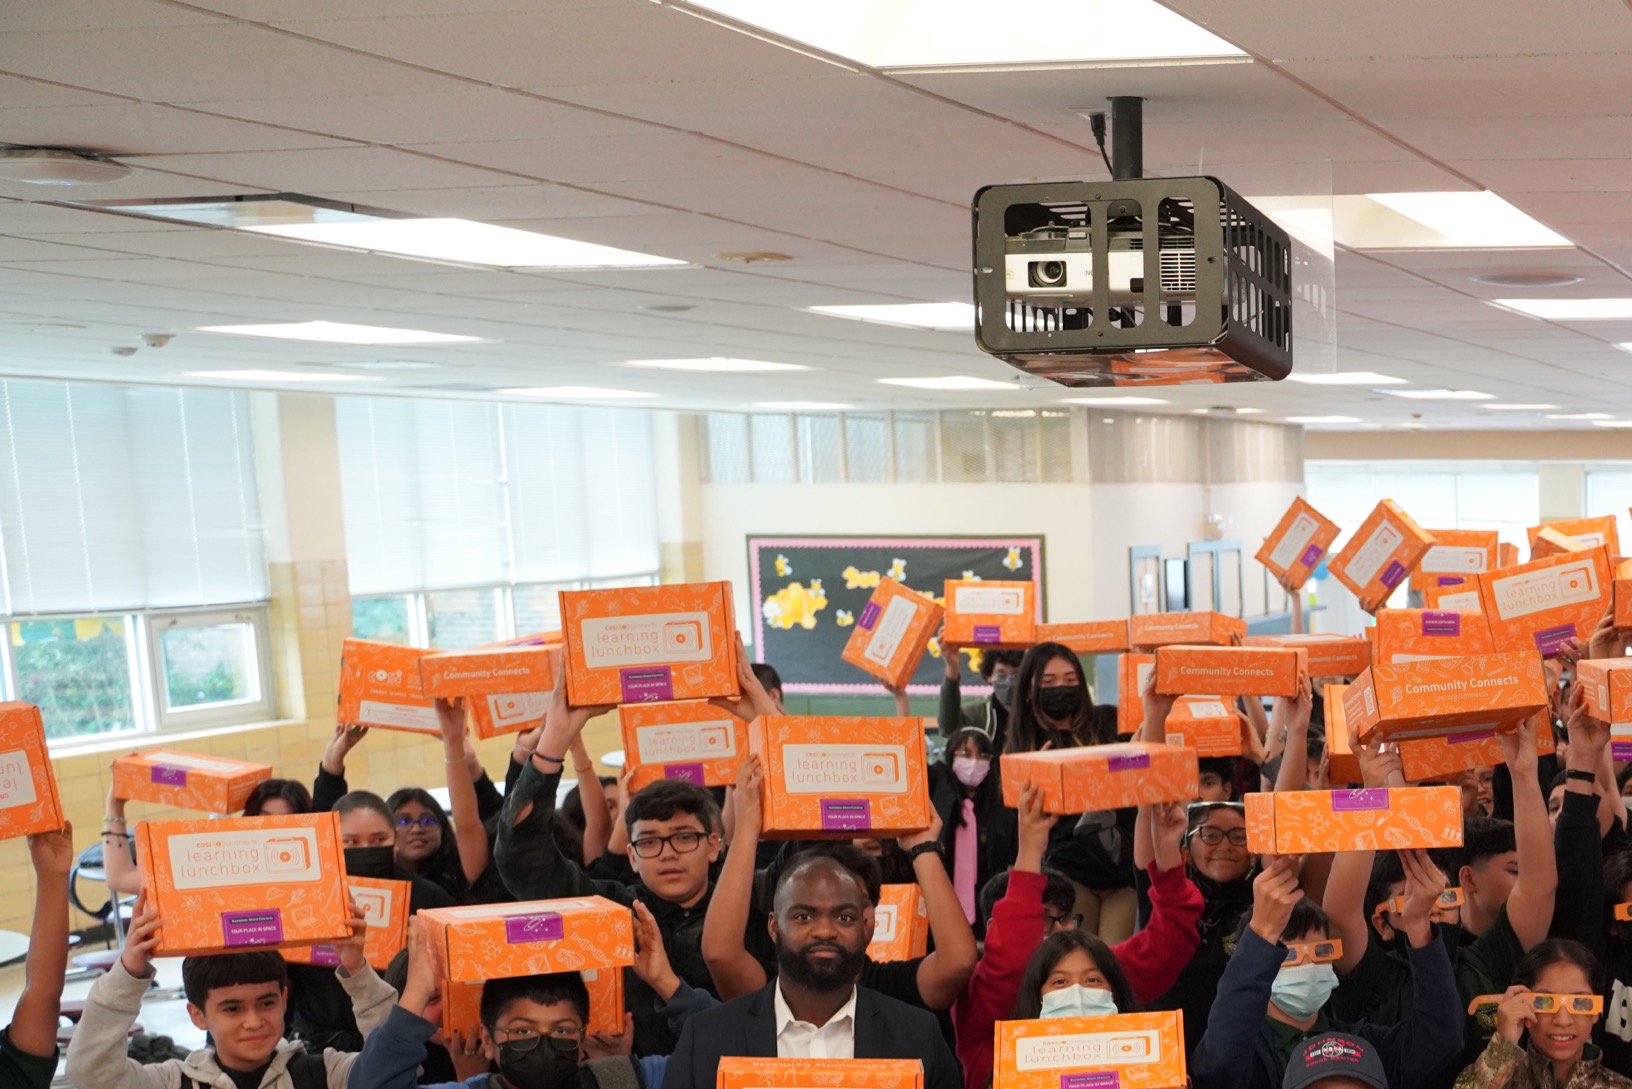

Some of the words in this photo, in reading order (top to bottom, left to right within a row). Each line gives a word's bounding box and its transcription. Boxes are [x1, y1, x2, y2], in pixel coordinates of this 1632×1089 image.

[1506, 582, 1556, 599] learning
[1503, 592, 1558, 611] lunchbox
[597, 631, 658, 643] learning
[592, 644, 659, 657] lunchbox
[444, 670, 490, 680] Community
[492, 667, 530, 676] Connects
[1181, 666, 1231, 677] Community
[1234, 667, 1274, 676] Connects
[1406, 680, 1467, 694] Community
[1470, 675, 1518, 688] Connects
[798, 759, 856, 774] learning
[792, 772, 857, 783] lunchbox
[187, 849, 259, 863] learning
[181, 863, 261, 878] lunchbox
[1033, 1045, 1101, 1054] learning
[1025, 1053, 1101, 1064] lunchbox
